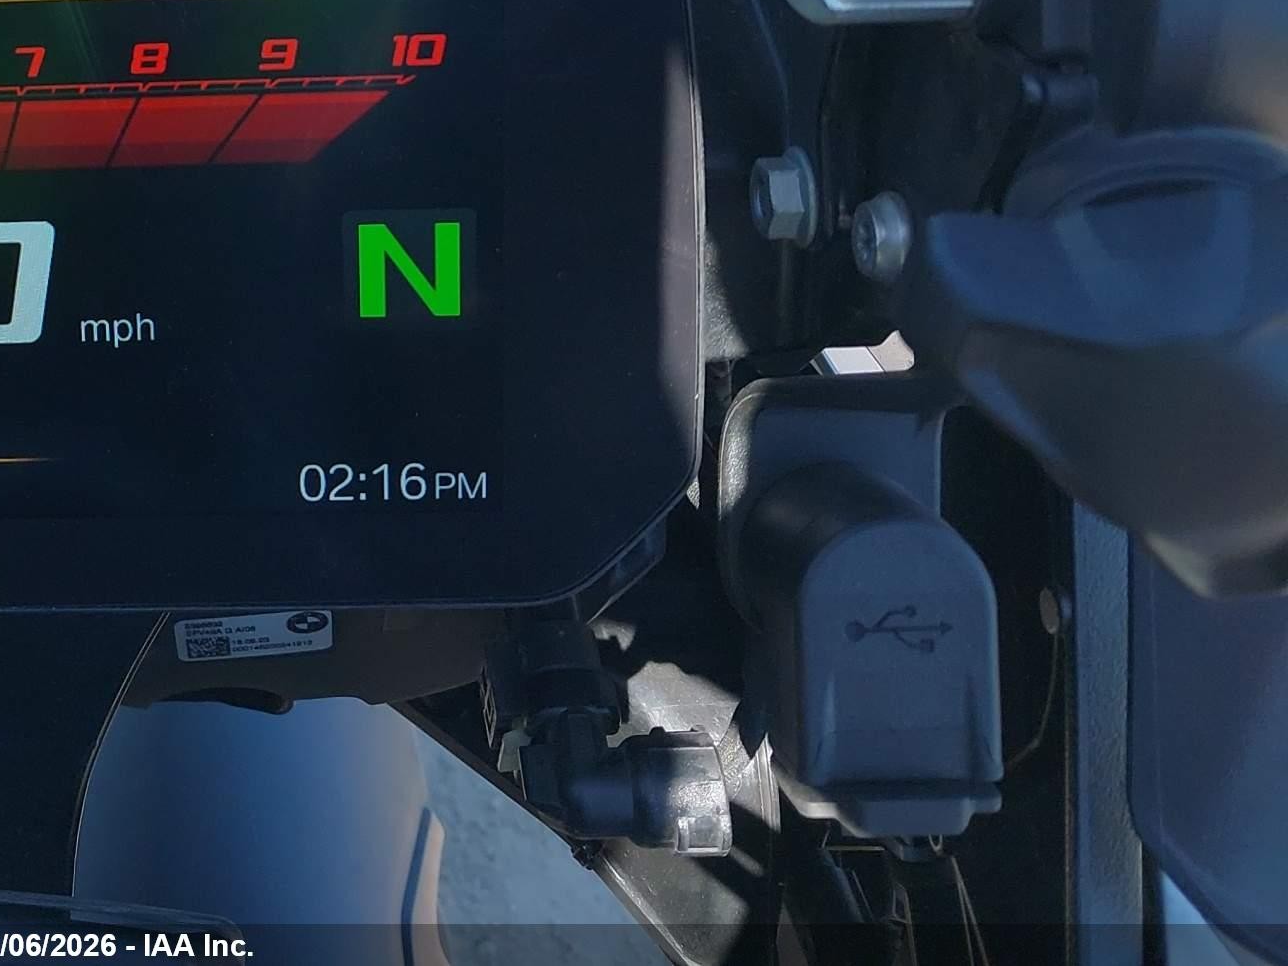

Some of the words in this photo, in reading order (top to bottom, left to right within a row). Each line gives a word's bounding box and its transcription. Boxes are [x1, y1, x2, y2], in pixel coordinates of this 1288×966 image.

[16, 47, 45, 77] 7
[131, 43, 168, 74] 8
[260, 39, 297, 70] 9
[393, 34, 445, 66] 10
[358, 222, 460, 317] N
[81, 313, 154, 348] mph
[300, 463, 426, 501] 02:16
[436, 474, 486, 499] PM
